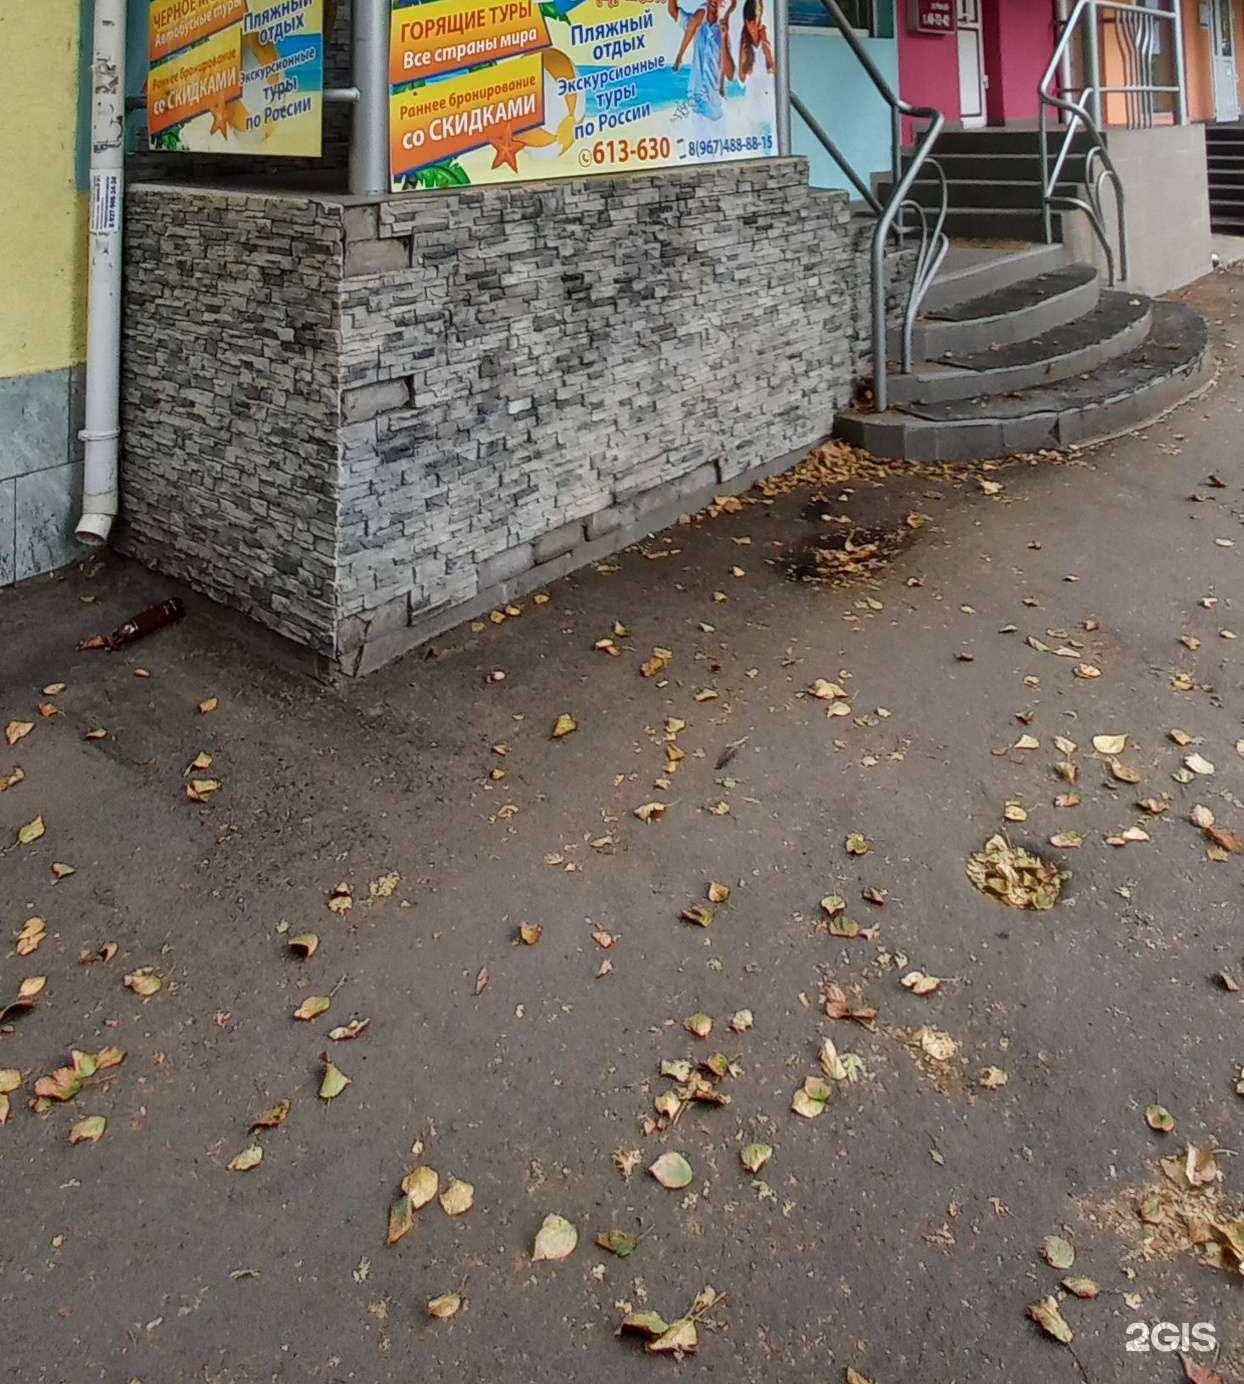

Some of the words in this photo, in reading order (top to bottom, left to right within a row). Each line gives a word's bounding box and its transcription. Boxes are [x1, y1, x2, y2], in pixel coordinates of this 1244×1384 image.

[154, 7, 213, 48] Автобусные
[259, 13, 304, 44] отдых
[401, 9, 486, 42] ГОРЯЩИЕ
[489, 0, 532, 26] ТУРЫ
[570, 10, 654, 46] Пляжный
[240, 47, 315, 86] Экскурсионные
[403, 50, 430, 69] Все
[435, 39, 497, 65] страны
[501, 27, 537, 52] мира
[593, 35, 645, 61] отдых
[153, 96, 165, 115] со
[167, 69, 237, 110] СКИДКАМИ
[263, 77, 297, 103] туры
[557, 55, 665, 96] Экскурсионные
[246, 112, 261, 130] по
[263, 98, 311, 128] России
[400, 93, 446, 120] Раннее
[448, 75, 536, 107] бронирование
[596, 83, 636, 108] туры
[402, 130, 424, 149] со
[429, 94, 536, 141] СКИДКАМИ
[574, 122, 594, 141] по
[599, 105, 651, 132] России
[592, 136, 670, 165] 613-630
[689, 135, 773, 157] 8(967)488-88-15
